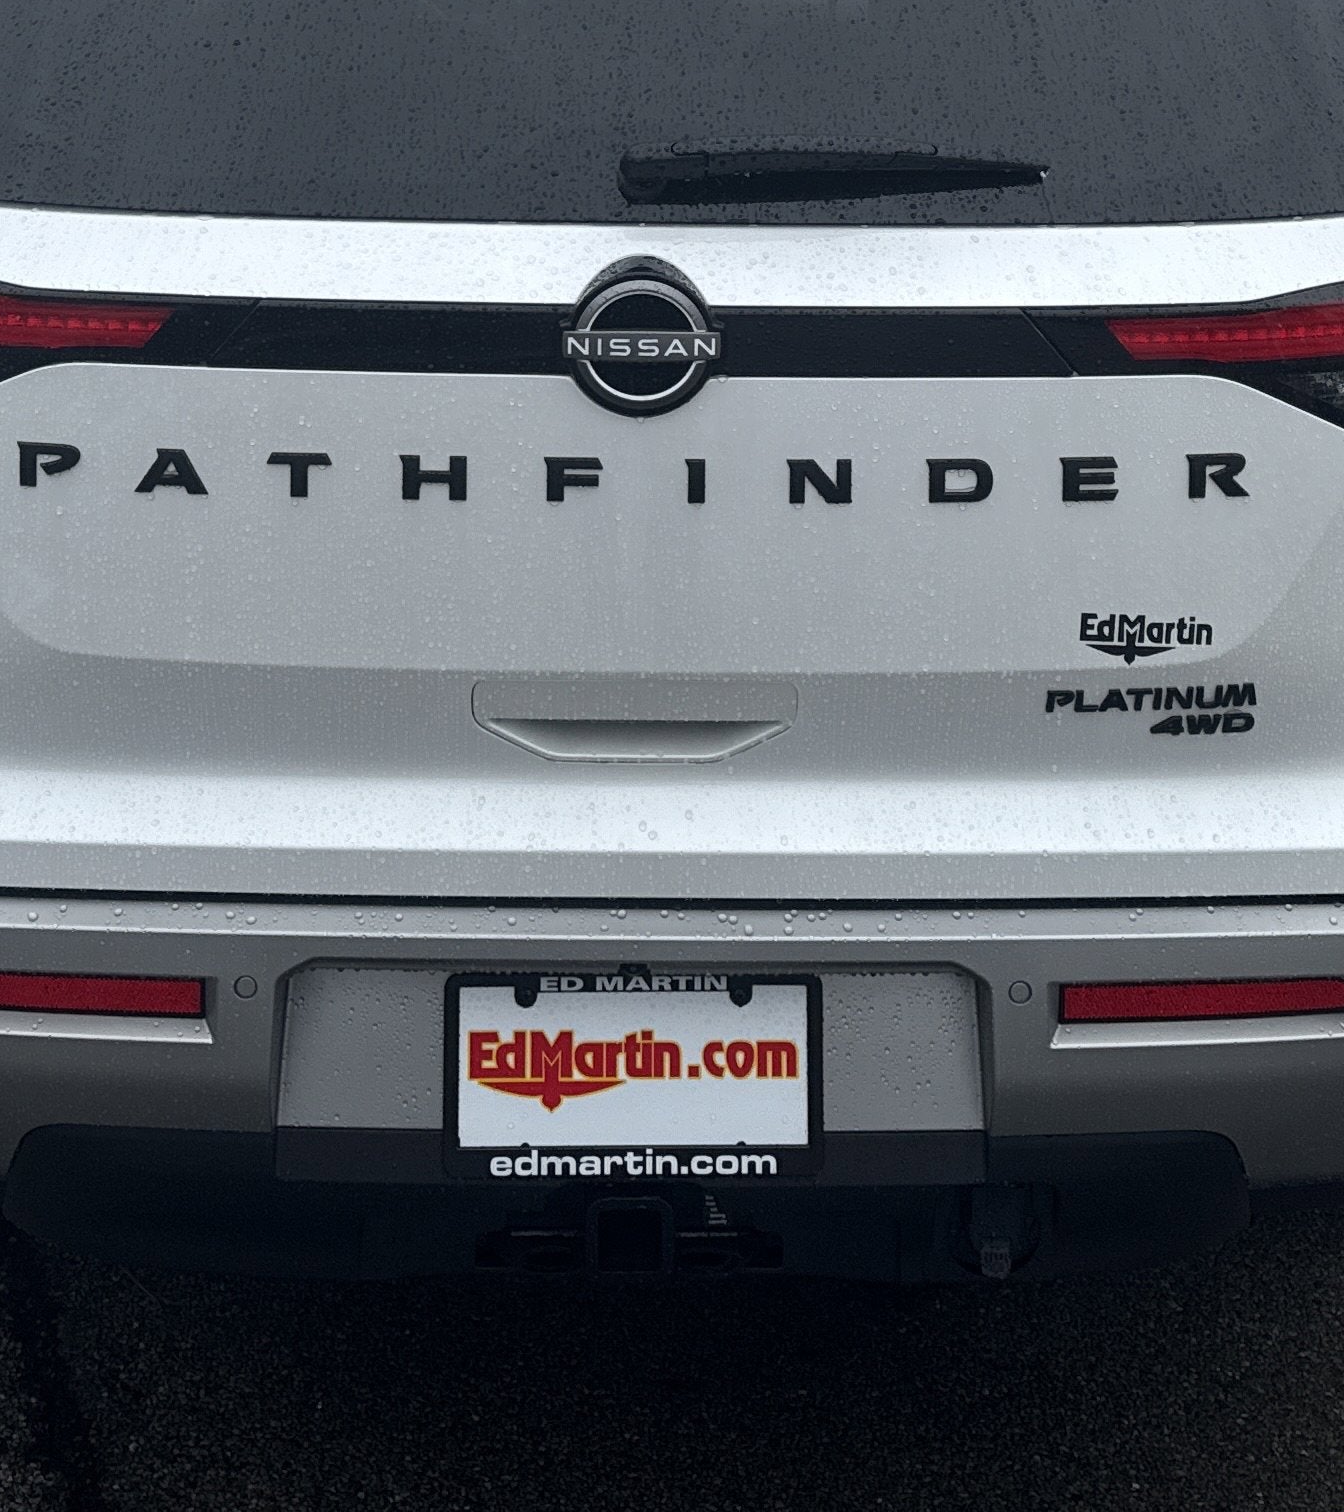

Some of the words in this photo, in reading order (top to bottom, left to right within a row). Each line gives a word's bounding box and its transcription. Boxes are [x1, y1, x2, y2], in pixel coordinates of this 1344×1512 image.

[567, 337, 716, 356] NISSAN
[16, 440, 1251, 505] PATHFINDER
[1045, 682, 1257, 713] PLATINUM
[1149, 713, 1256, 735] 4WD
[539, 976, 584, 991] ED
[595, 976, 729, 992] MARTIN
[489, 1149, 778, 1178] edmartin.com
